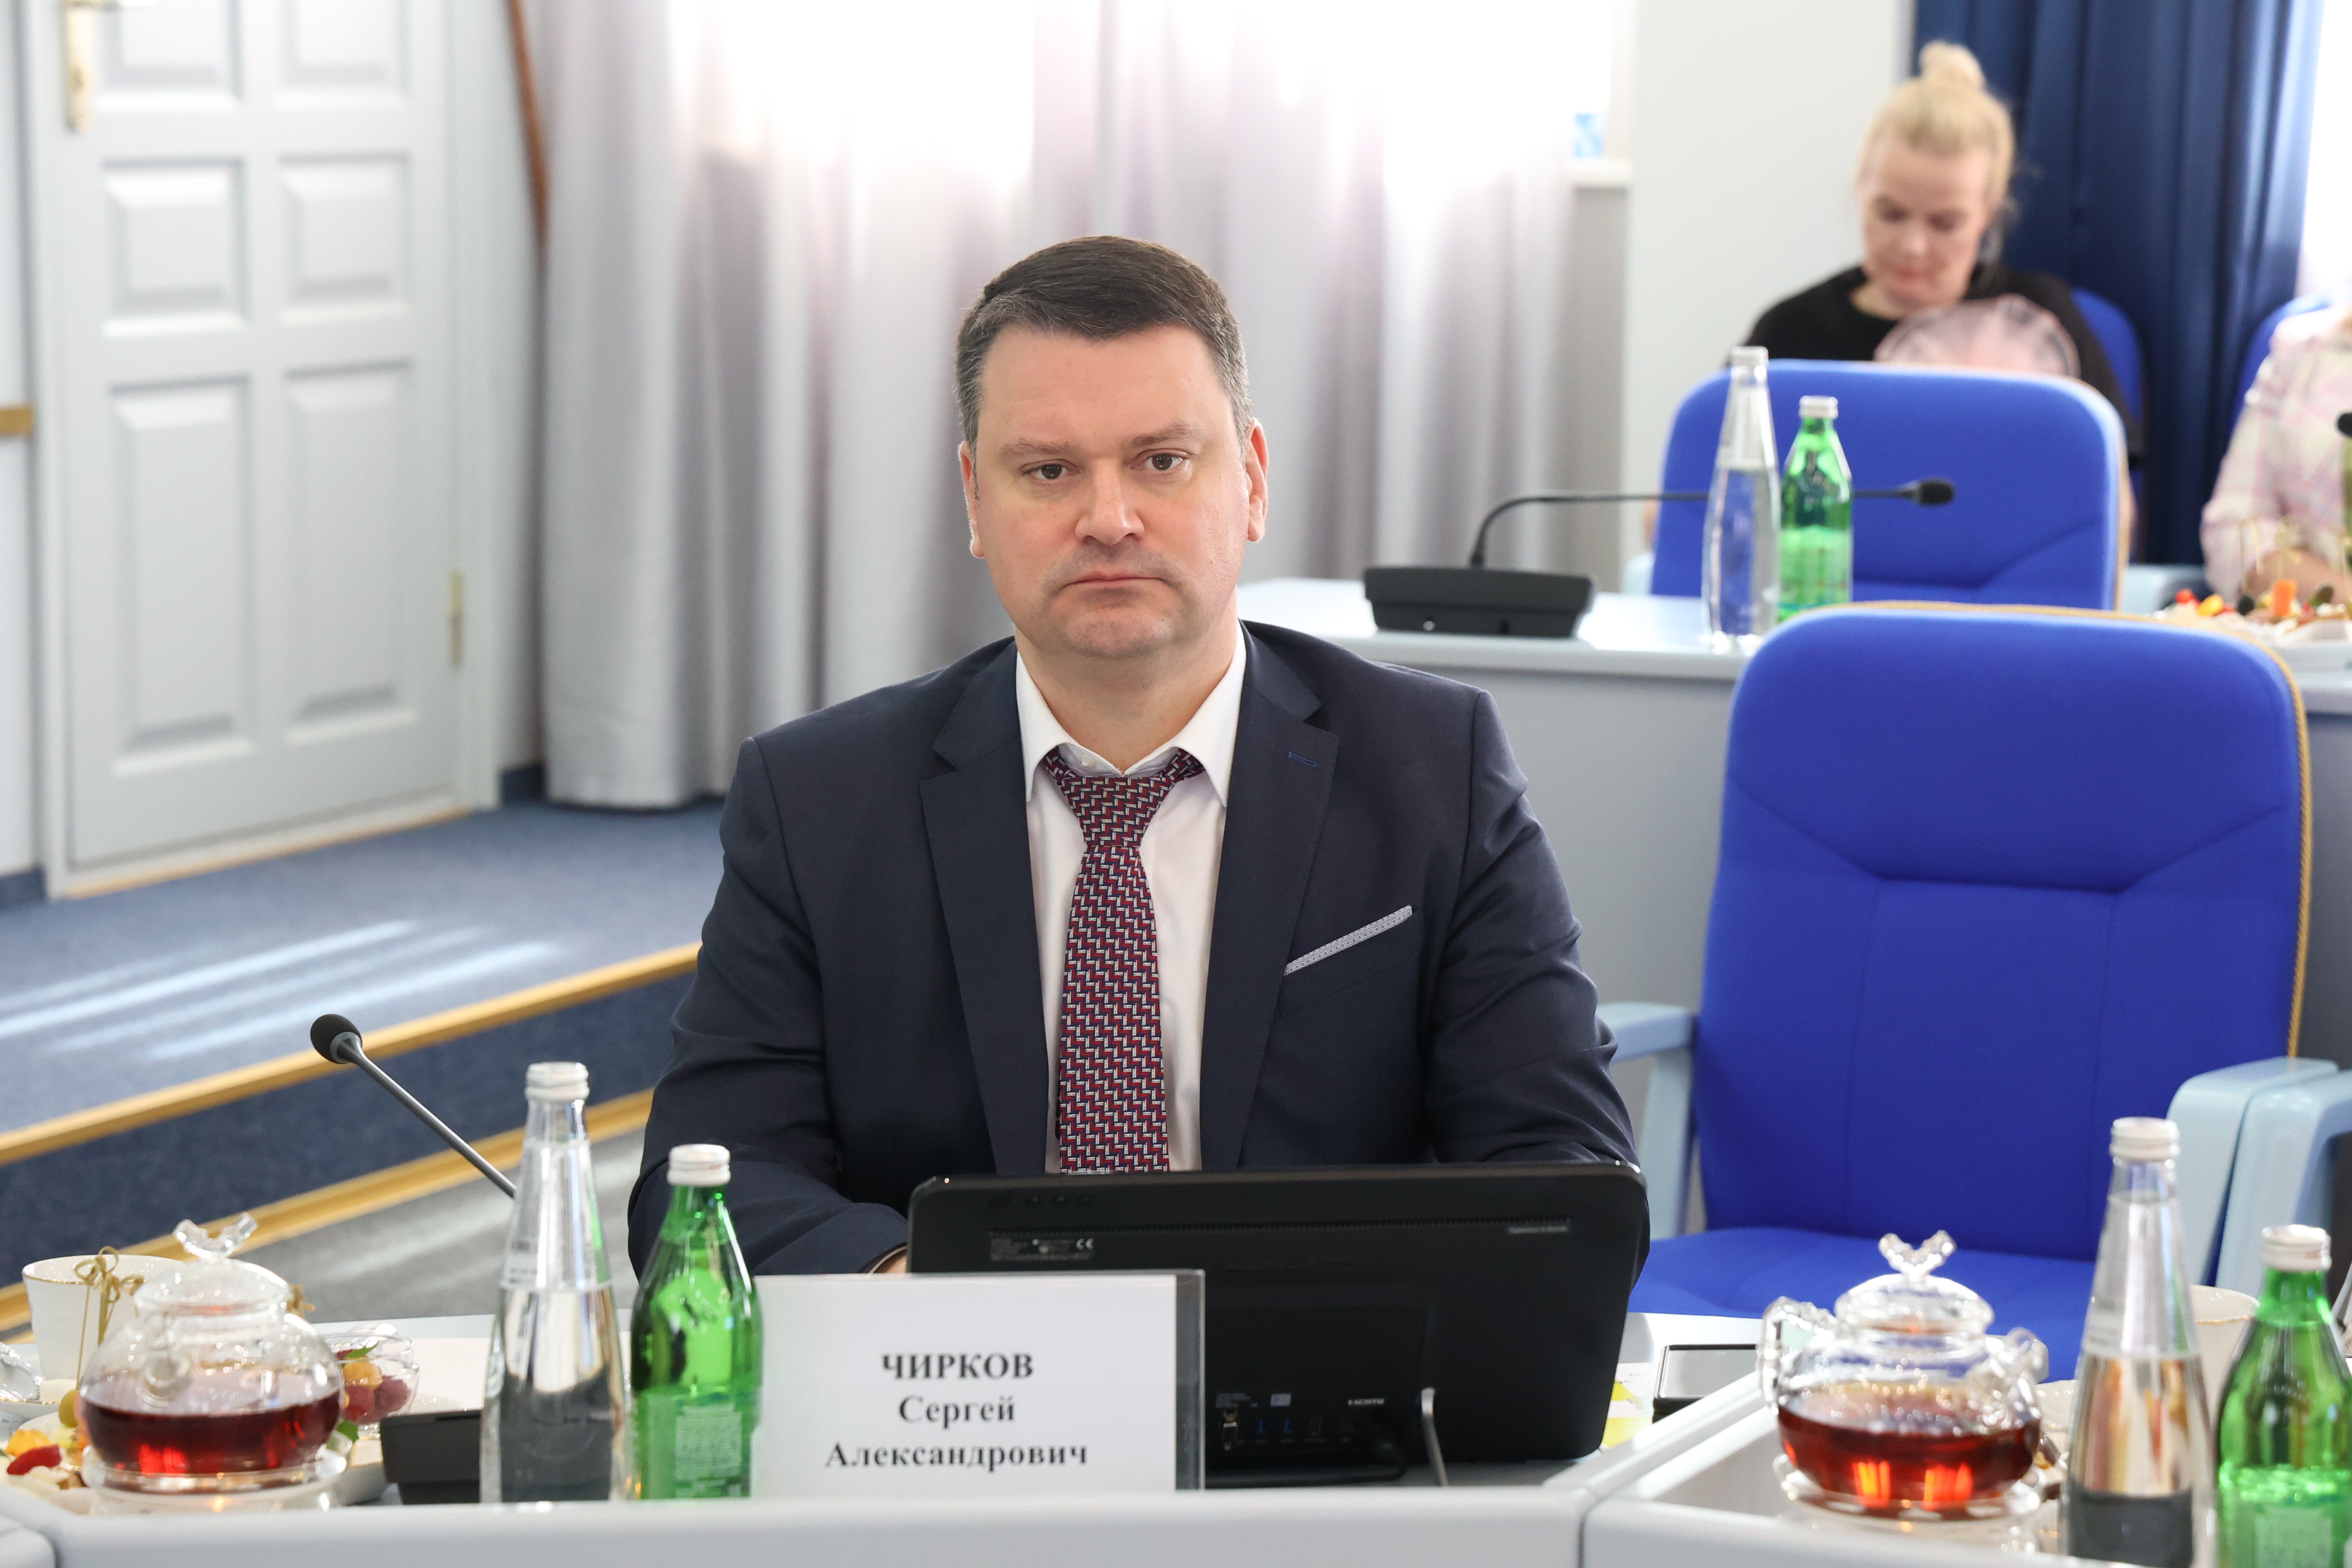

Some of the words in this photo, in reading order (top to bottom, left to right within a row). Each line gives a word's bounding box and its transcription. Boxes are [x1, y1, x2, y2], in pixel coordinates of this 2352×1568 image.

[882, 1353, 1033, 1379] ЧИРКОВ
[898, 1395, 1015, 1429] Сергей
[825, 1442, 1087, 1473] Александрович
